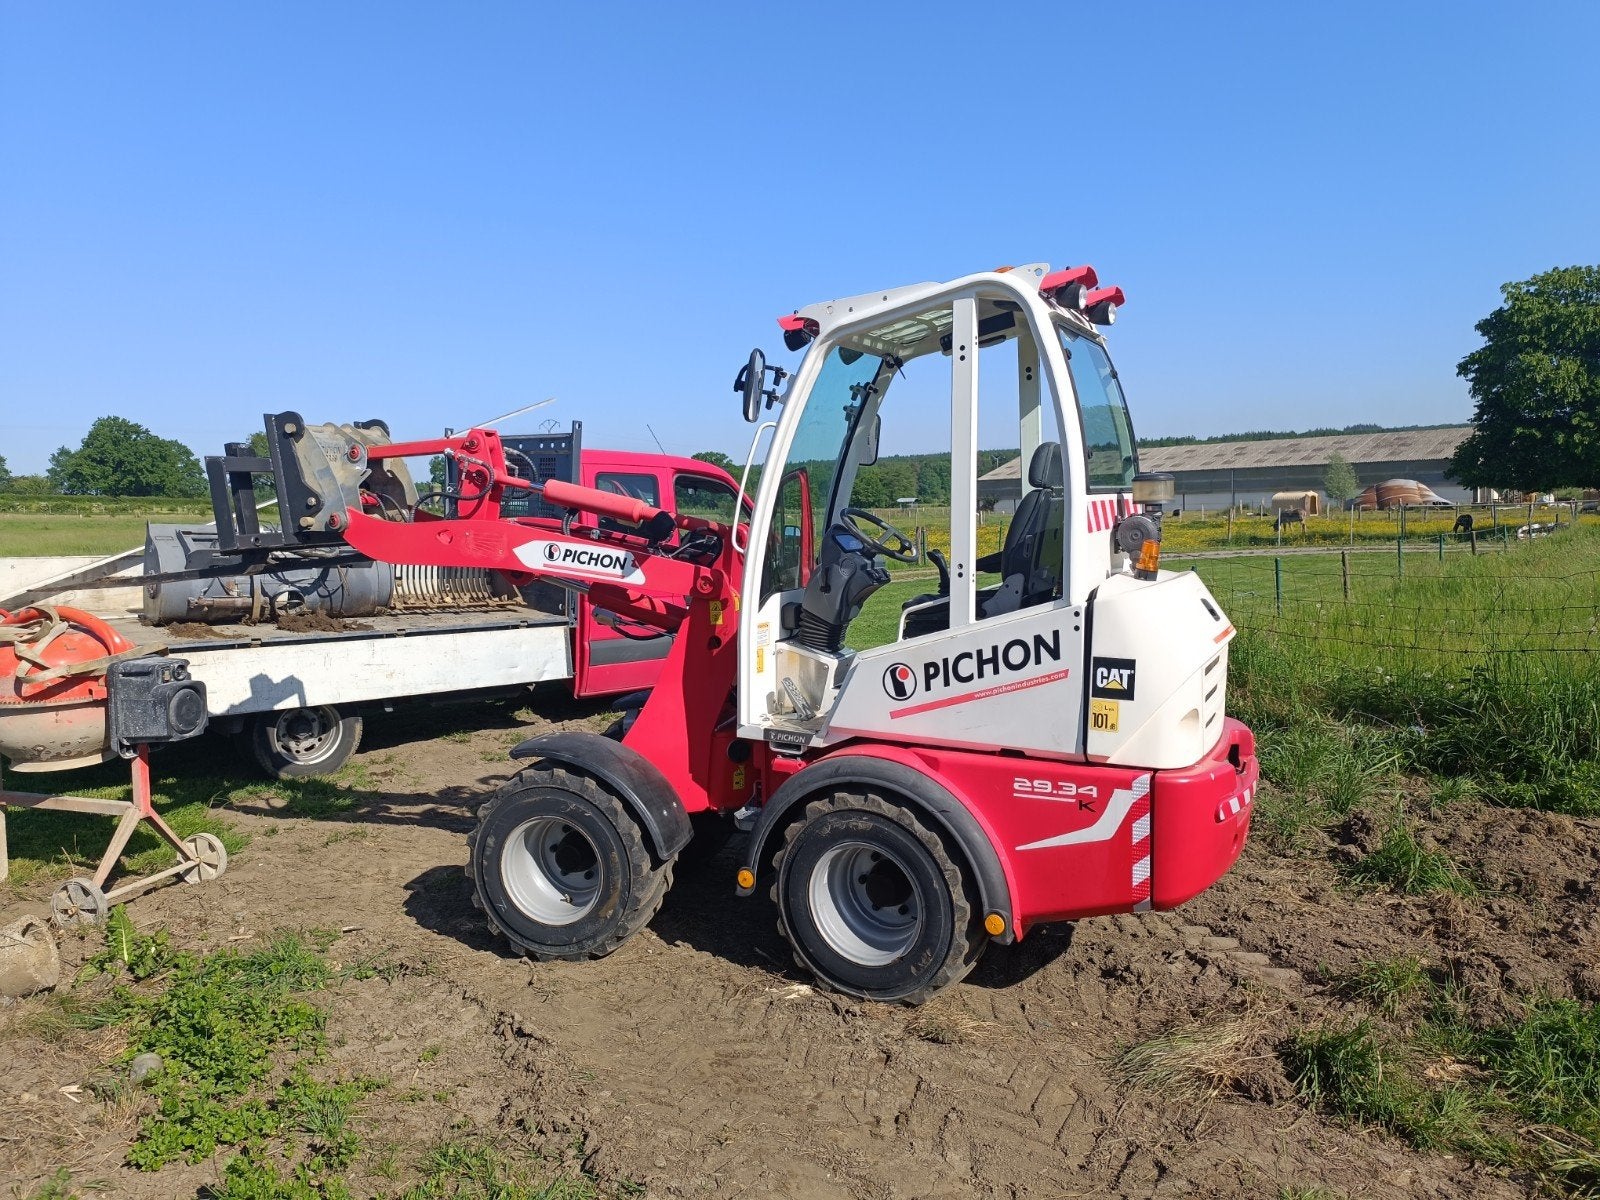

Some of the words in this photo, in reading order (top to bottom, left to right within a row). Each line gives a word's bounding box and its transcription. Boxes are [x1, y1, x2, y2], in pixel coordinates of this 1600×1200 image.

[562, 549, 628, 570] PICHON
[924, 629, 1061, 692] PICHON
[974, 671, 1066, 699] www.pichonindustries.com
[1096, 667, 1131, 690] CAT
[1092, 712, 1109, 730] 101
[777, 732, 806, 744] PICHON
[1013, 777, 1098, 798] 29.34
[1078, 799, 1097, 813] K
